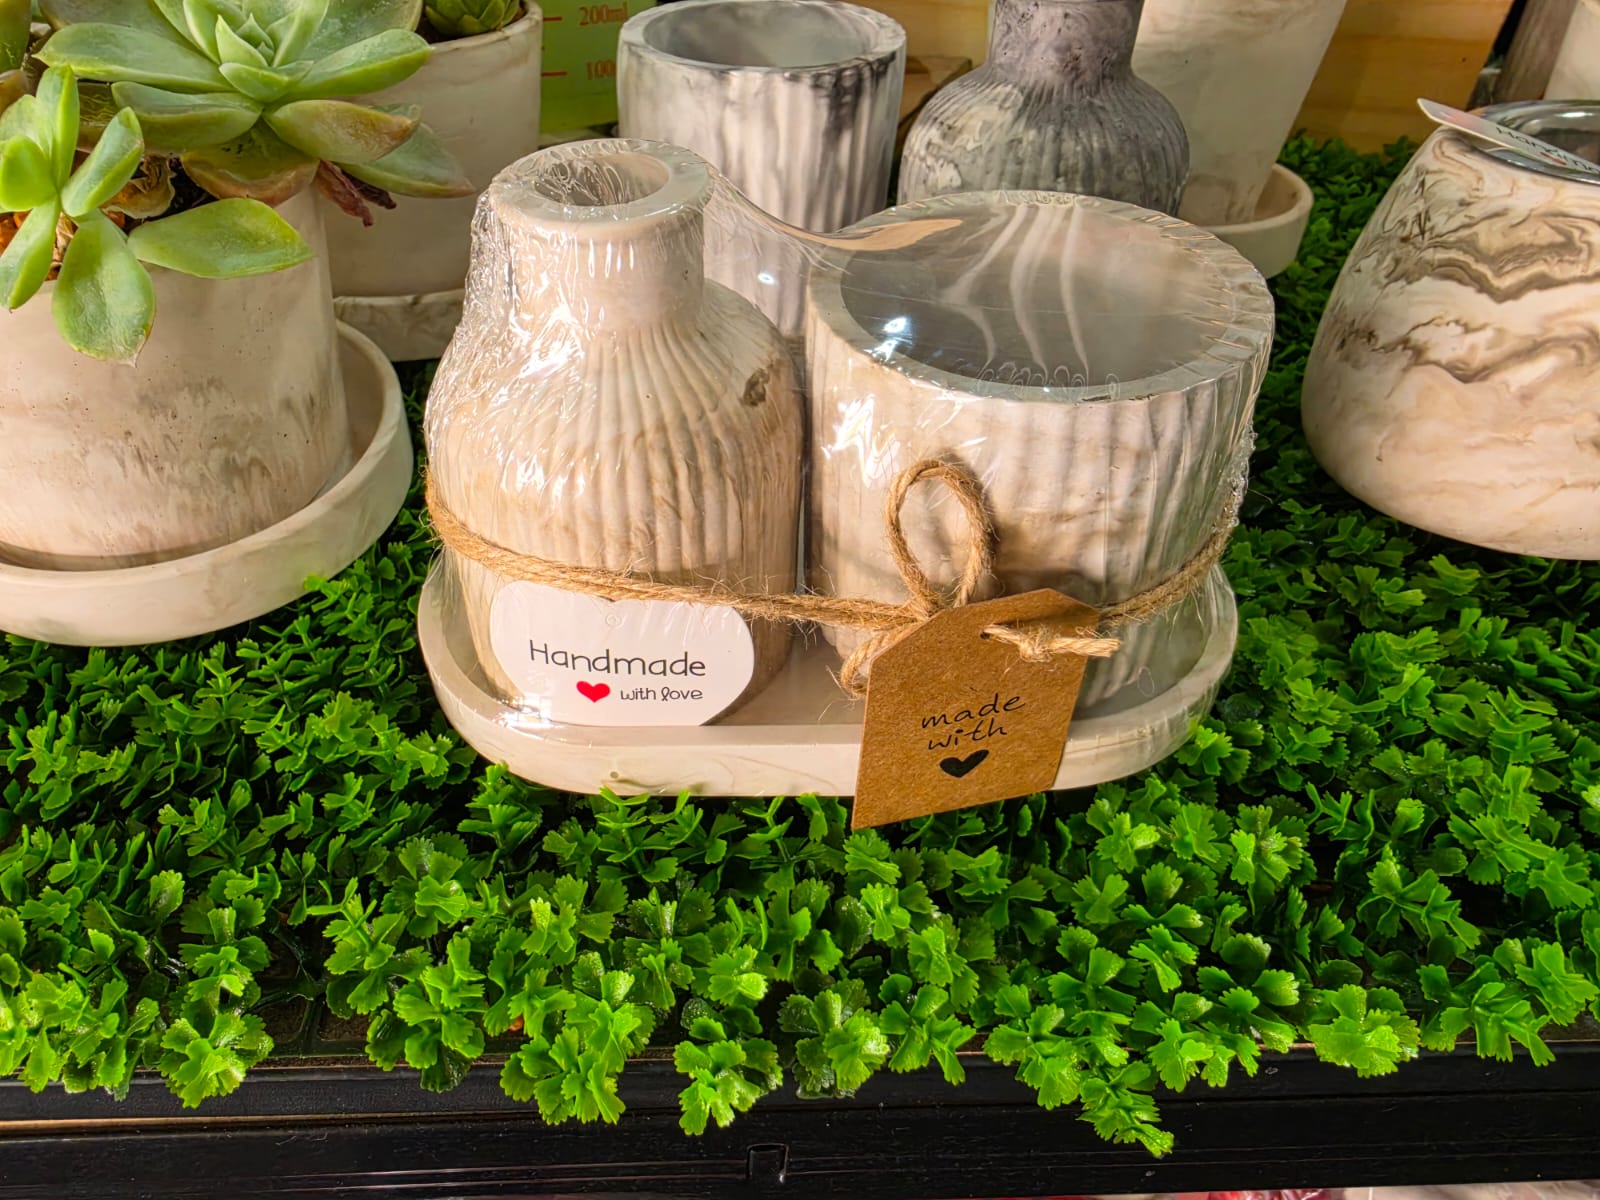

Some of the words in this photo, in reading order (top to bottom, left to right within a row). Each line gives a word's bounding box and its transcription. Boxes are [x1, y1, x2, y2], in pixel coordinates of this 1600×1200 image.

[579, 2, 628, 26] 200ml
[586, 59, 617, 81] 100
[529, 639, 706, 677] Handmade
[620, 687, 657, 701] with
[661, 686, 703, 701] love
[921, 692, 1026, 729] made
[928, 717, 1008, 750] with
